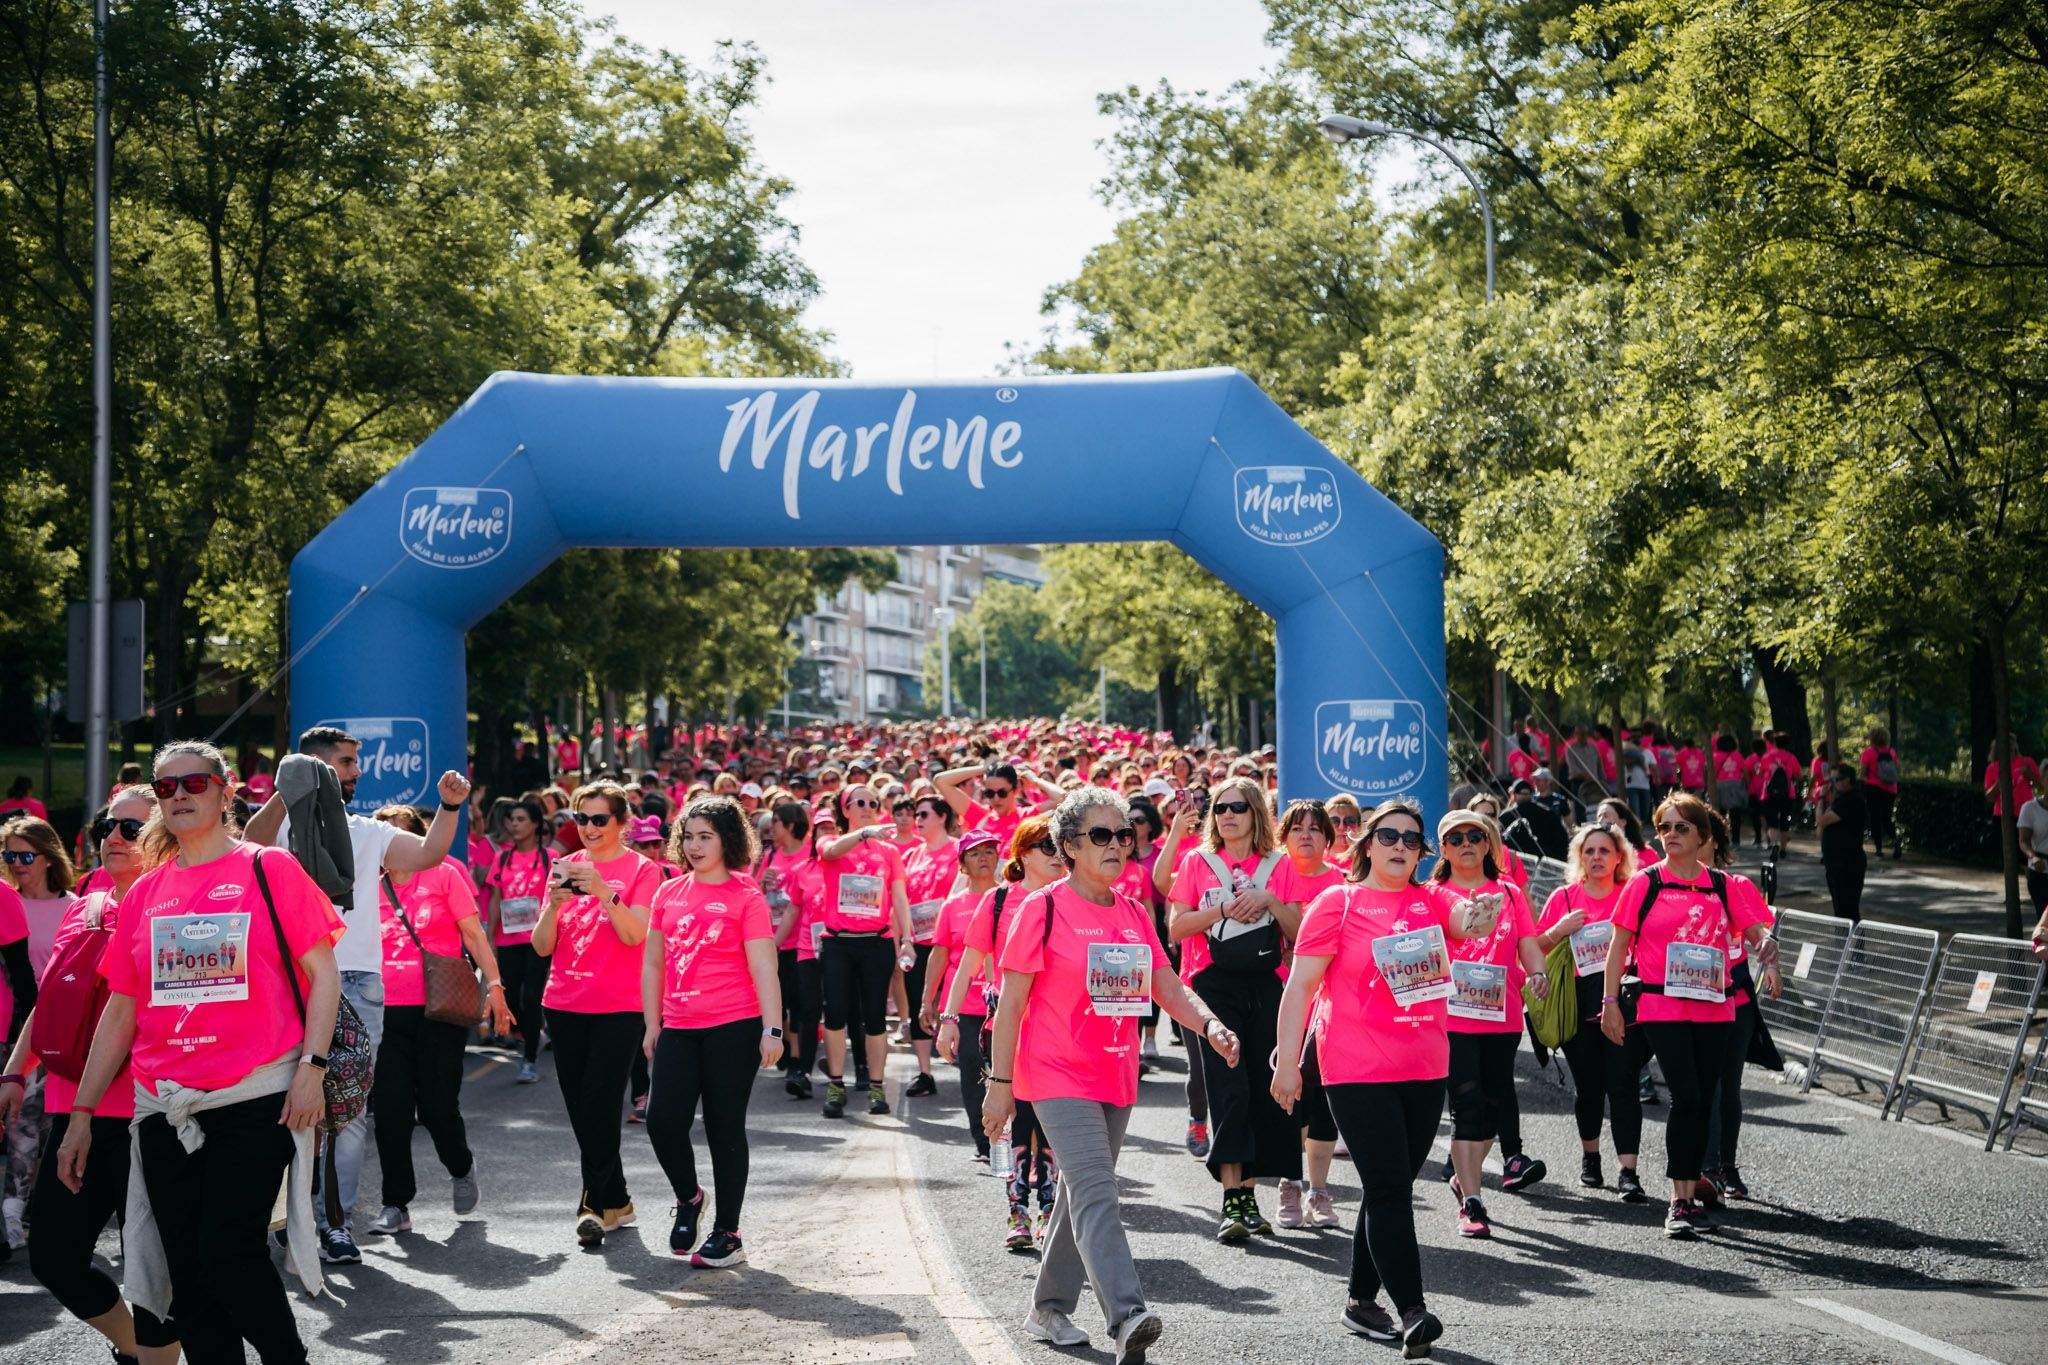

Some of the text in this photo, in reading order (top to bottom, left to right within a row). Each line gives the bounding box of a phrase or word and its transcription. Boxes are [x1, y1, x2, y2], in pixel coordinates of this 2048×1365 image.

[719, 388, 1024, 520] Marlene
[1243, 482, 1335, 526] Marlene
[407, 504, 504, 546] Marlene
[1249, 520, 1330, 541] HIJA DE LOS ALPES
[432, 553, 446, 563] DE
[447, 556, 466, 564] LOS
[1323, 720, 1421, 771] Marlene
[358, 740, 422, 781] rlene
[1329, 767, 1415, 790] HIJA DE LOS ALPES
[185, 952, 218, 969] 016
[1404, 960, 1429, 976] 016
[194, 971, 207, 979] 713
[1107, 975, 1129, 988] 016
[1686, 967, 1710, 979] 016
[1469, 986, 1491, 998] 016
